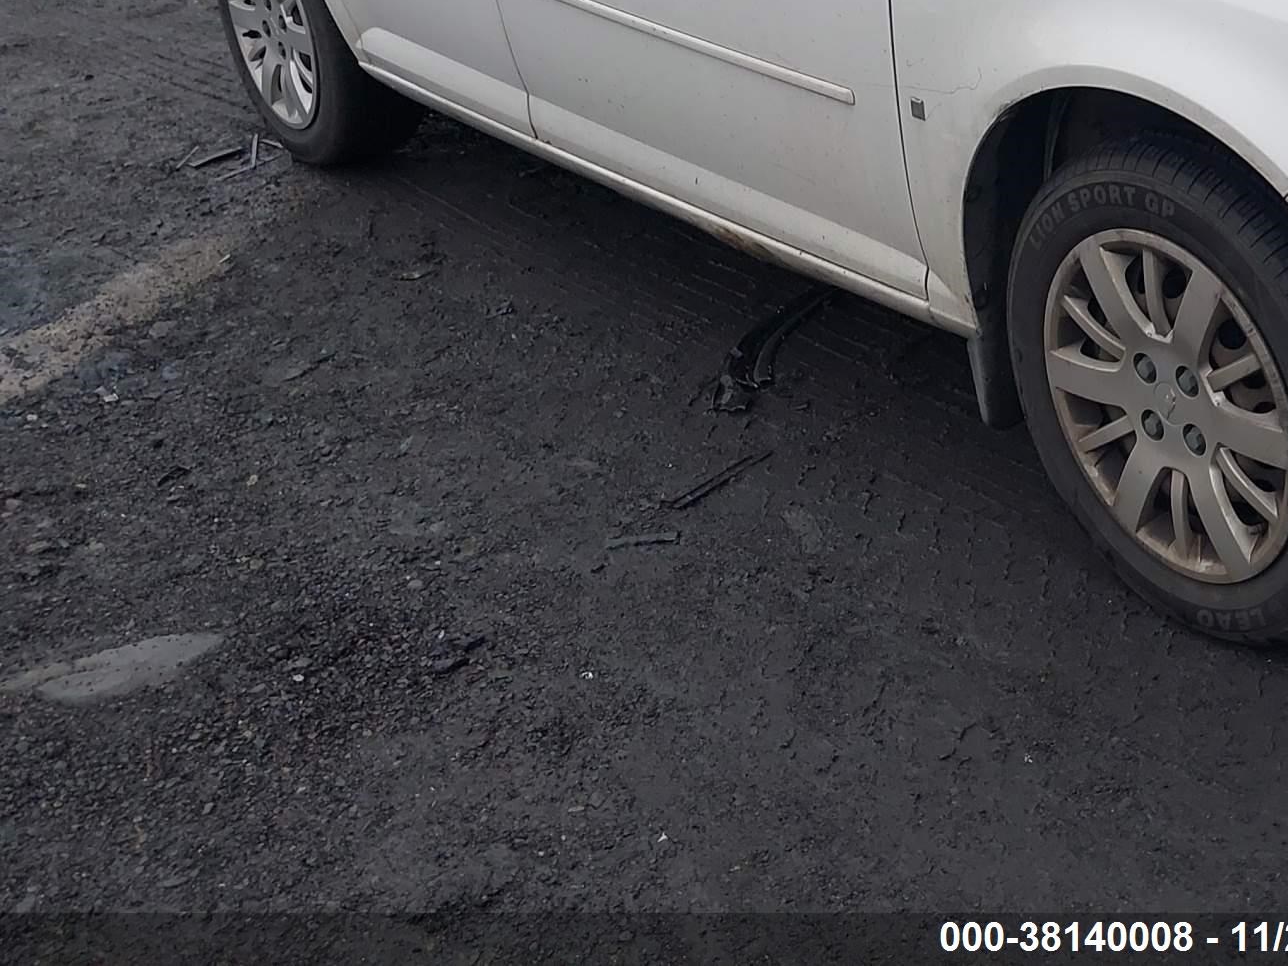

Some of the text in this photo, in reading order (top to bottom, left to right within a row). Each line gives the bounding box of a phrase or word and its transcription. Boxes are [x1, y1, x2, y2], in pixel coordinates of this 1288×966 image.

[1029, 184, 1176, 250] LION SPORT GP
[1196, 608, 1266, 630] LEAO
